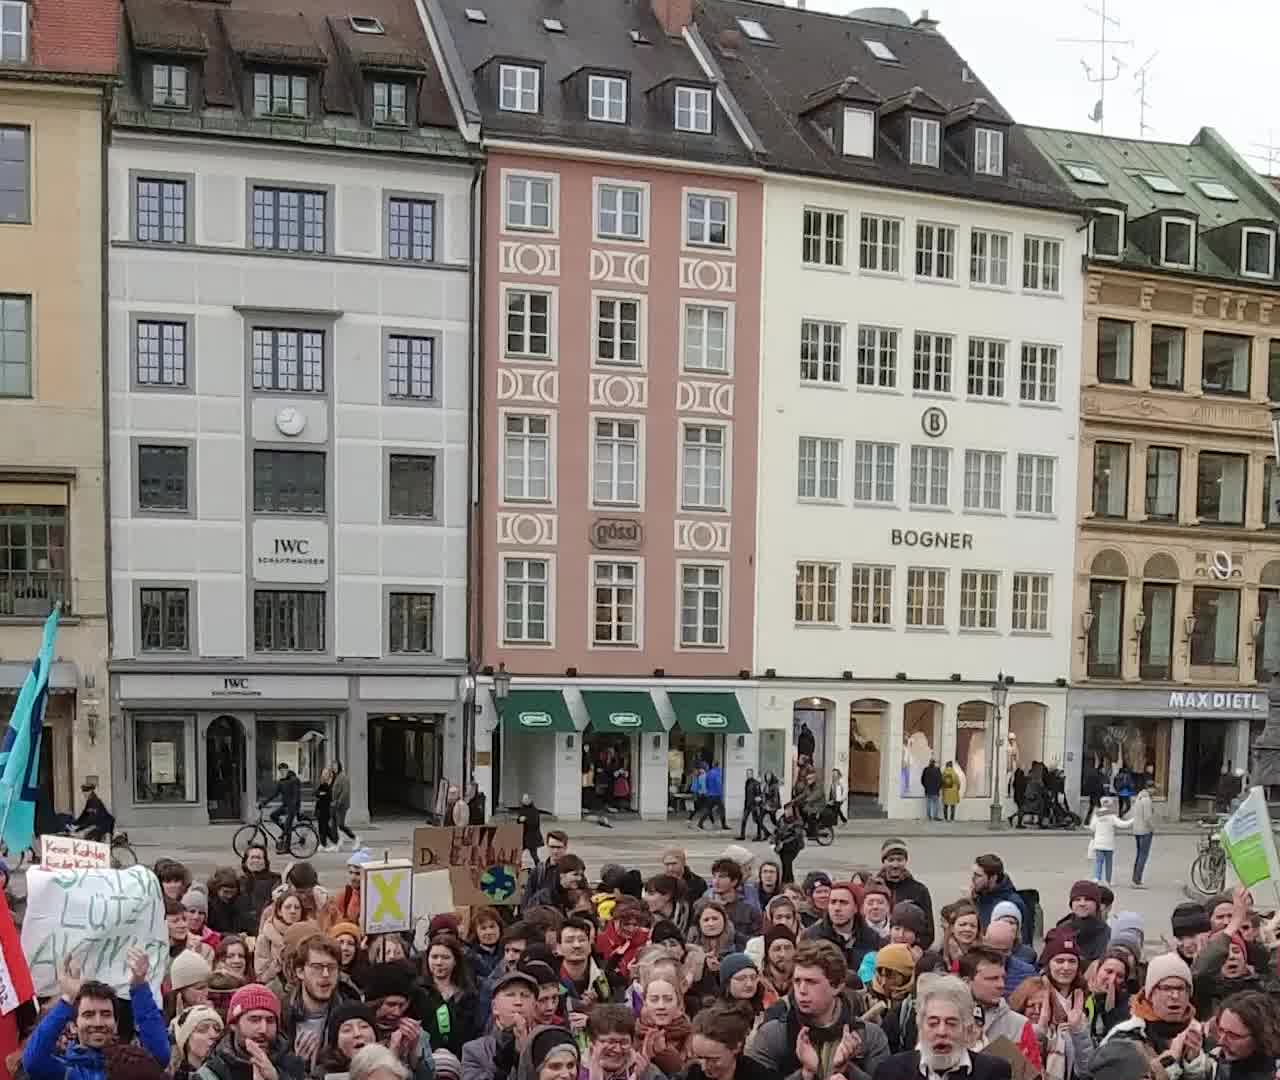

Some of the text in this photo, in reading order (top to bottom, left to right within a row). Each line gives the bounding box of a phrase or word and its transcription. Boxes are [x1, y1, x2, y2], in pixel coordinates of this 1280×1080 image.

[274, 539, 310, 554] IWC
[891, 529, 973, 550] BOGNER
[224, 678, 249, 689] IWC
[1169, 692, 1261, 710] MAX DIETL
